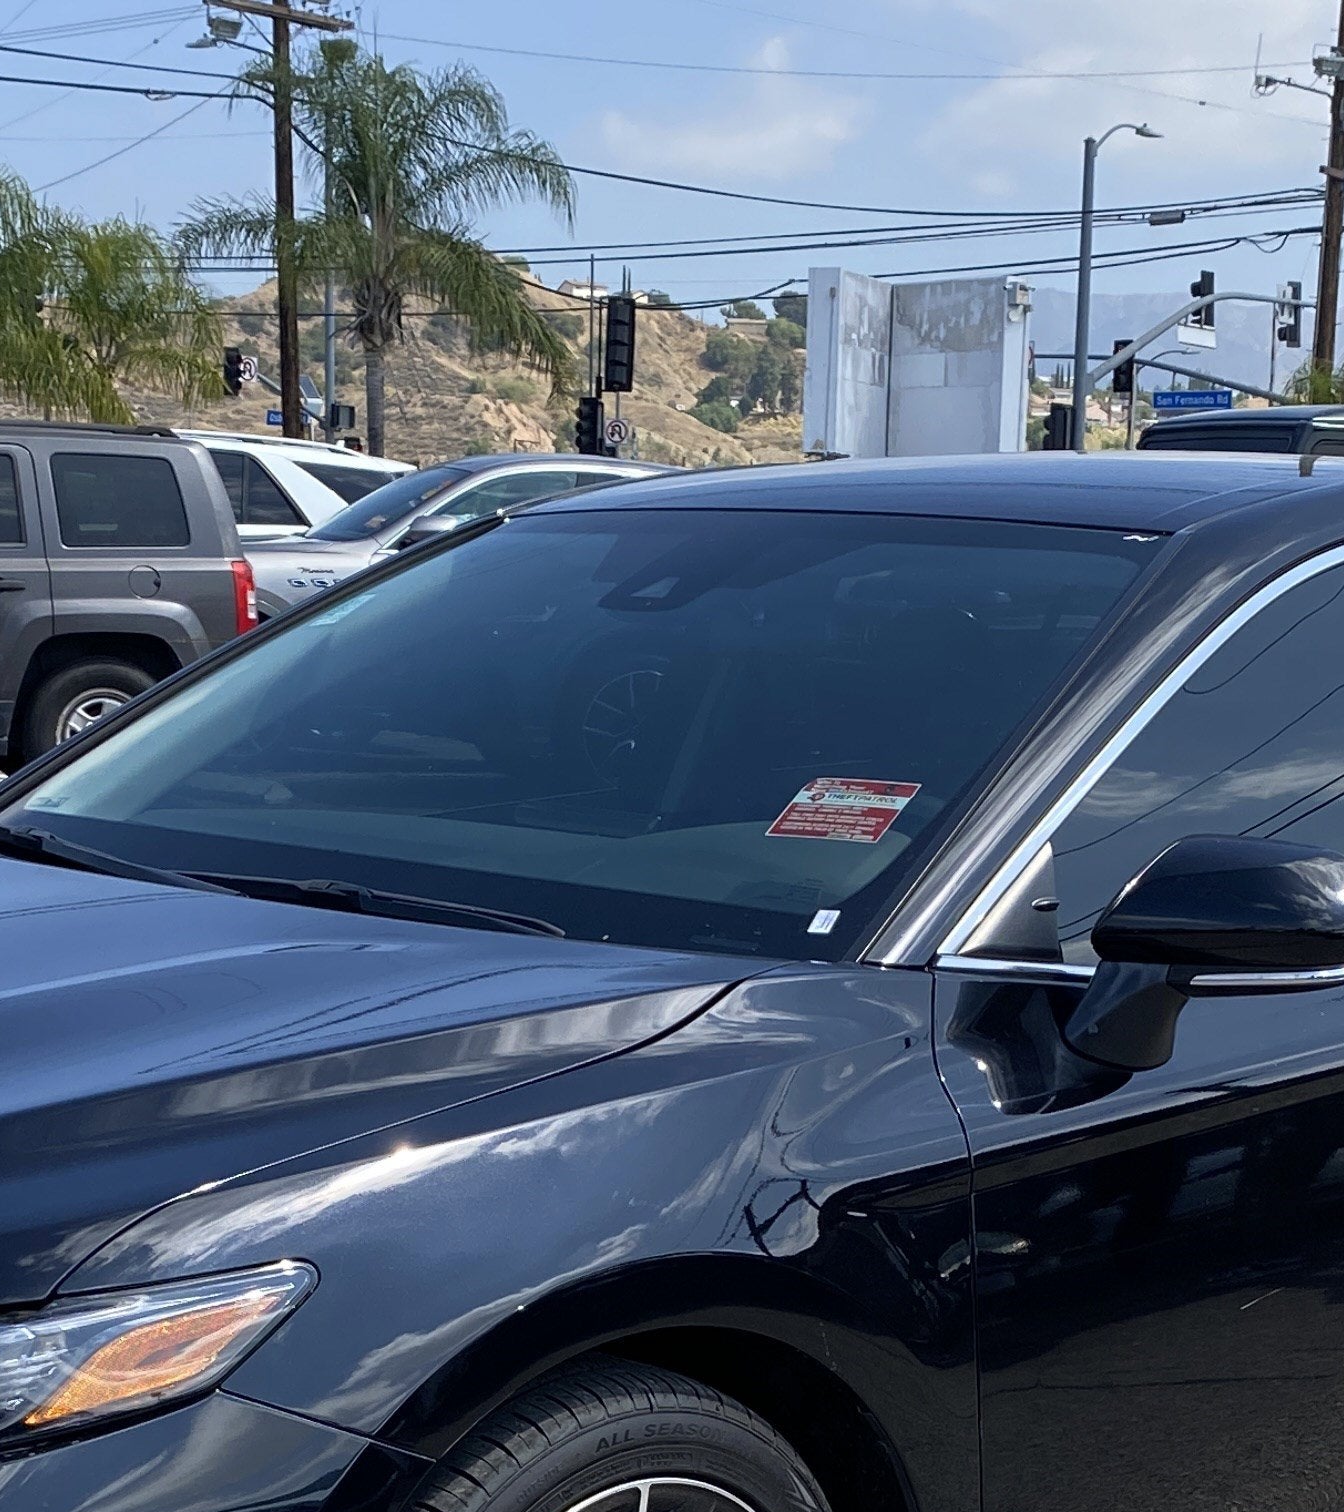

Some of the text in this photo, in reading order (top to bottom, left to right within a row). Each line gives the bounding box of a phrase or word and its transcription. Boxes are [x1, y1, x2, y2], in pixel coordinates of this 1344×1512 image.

[1156, 394, 1229, 406] San Fernando Rd
[595, 1422, 725, 1453] ALL SEASON
